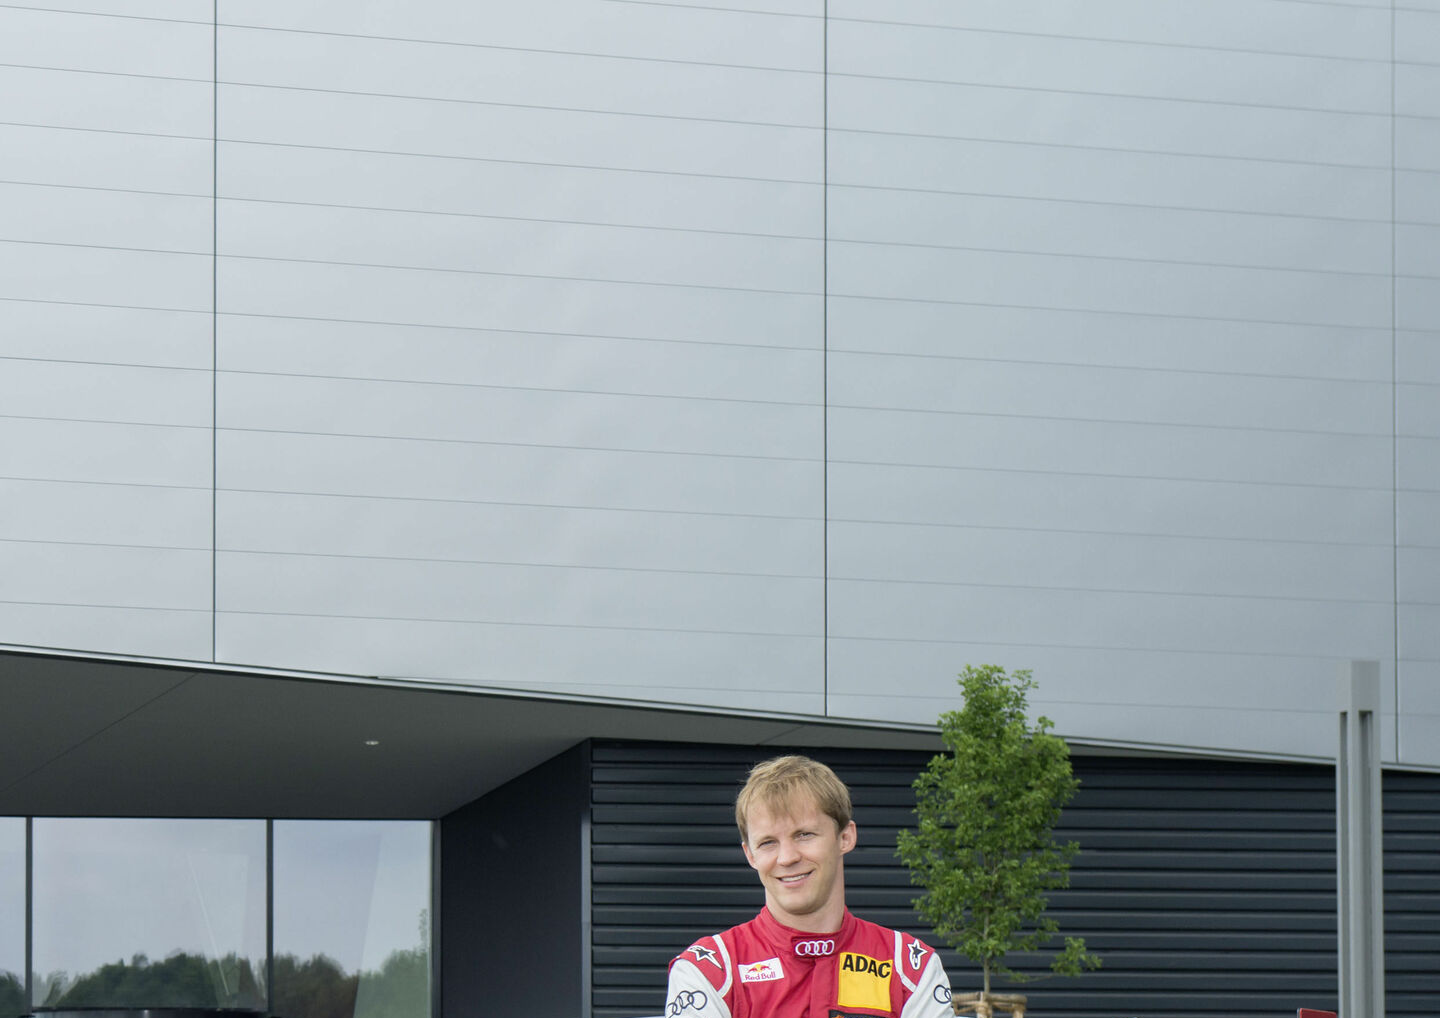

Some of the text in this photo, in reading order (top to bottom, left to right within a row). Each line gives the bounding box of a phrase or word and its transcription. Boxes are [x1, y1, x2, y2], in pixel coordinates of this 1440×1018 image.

[842, 954, 891, 978] ADAC
[745, 971, 776, 981] Red Bull
